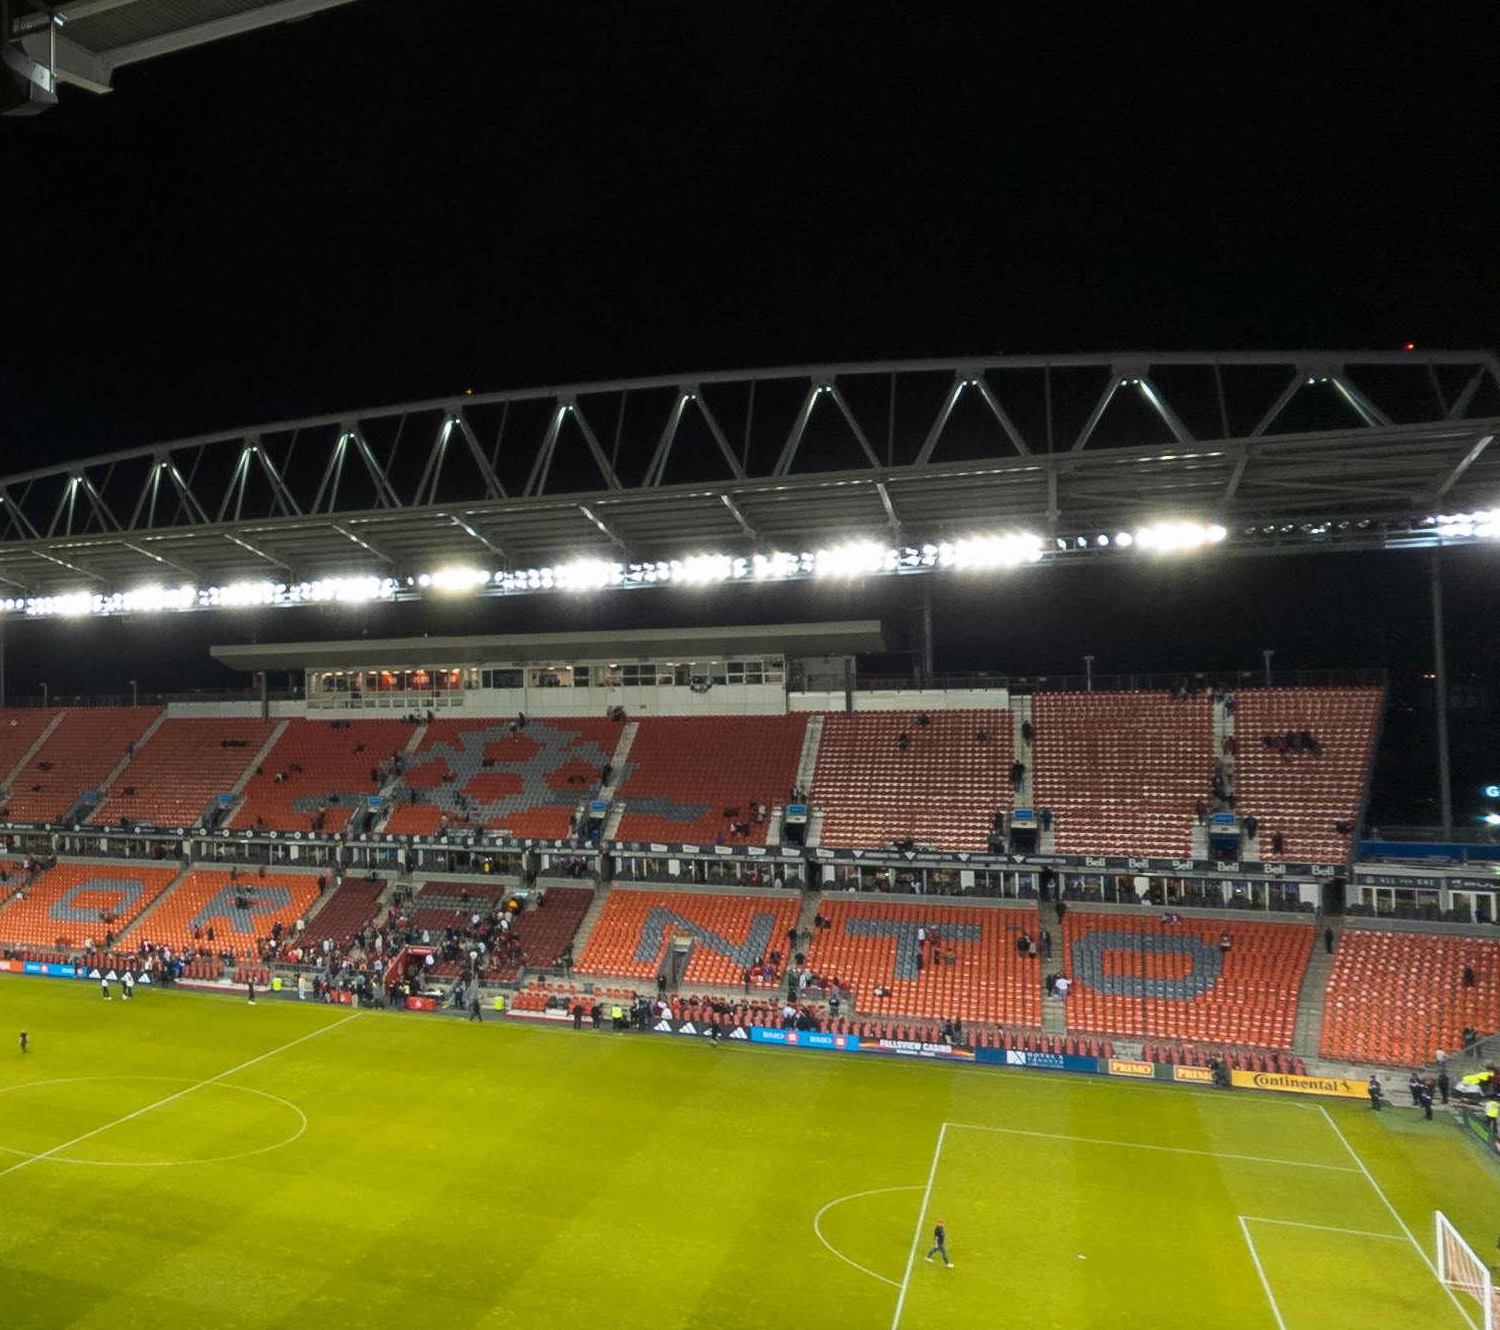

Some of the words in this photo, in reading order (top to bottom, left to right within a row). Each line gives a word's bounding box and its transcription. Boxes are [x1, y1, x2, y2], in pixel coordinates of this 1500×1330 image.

[1085, 857, 1106, 867] Bell
[1128, 858, 1149, 868] Bell
[1172, 860, 1193, 870] Bell
[1217, 861, 1239, 872] Bell
[1264, 863, 1286, 874] Bell
[1311, 865, 1334, 876] Bell
[762, 1031, 785, 1041] BMO
[810, 1035, 832, 1045] BMO
[879, 1039, 921, 1051] FALLSVIEW
[923, 1042, 952, 1054] CASINO
[1112, 1062, 1151, 1075] PRIMO
[1253, 1073, 1338, 1092] Continental
